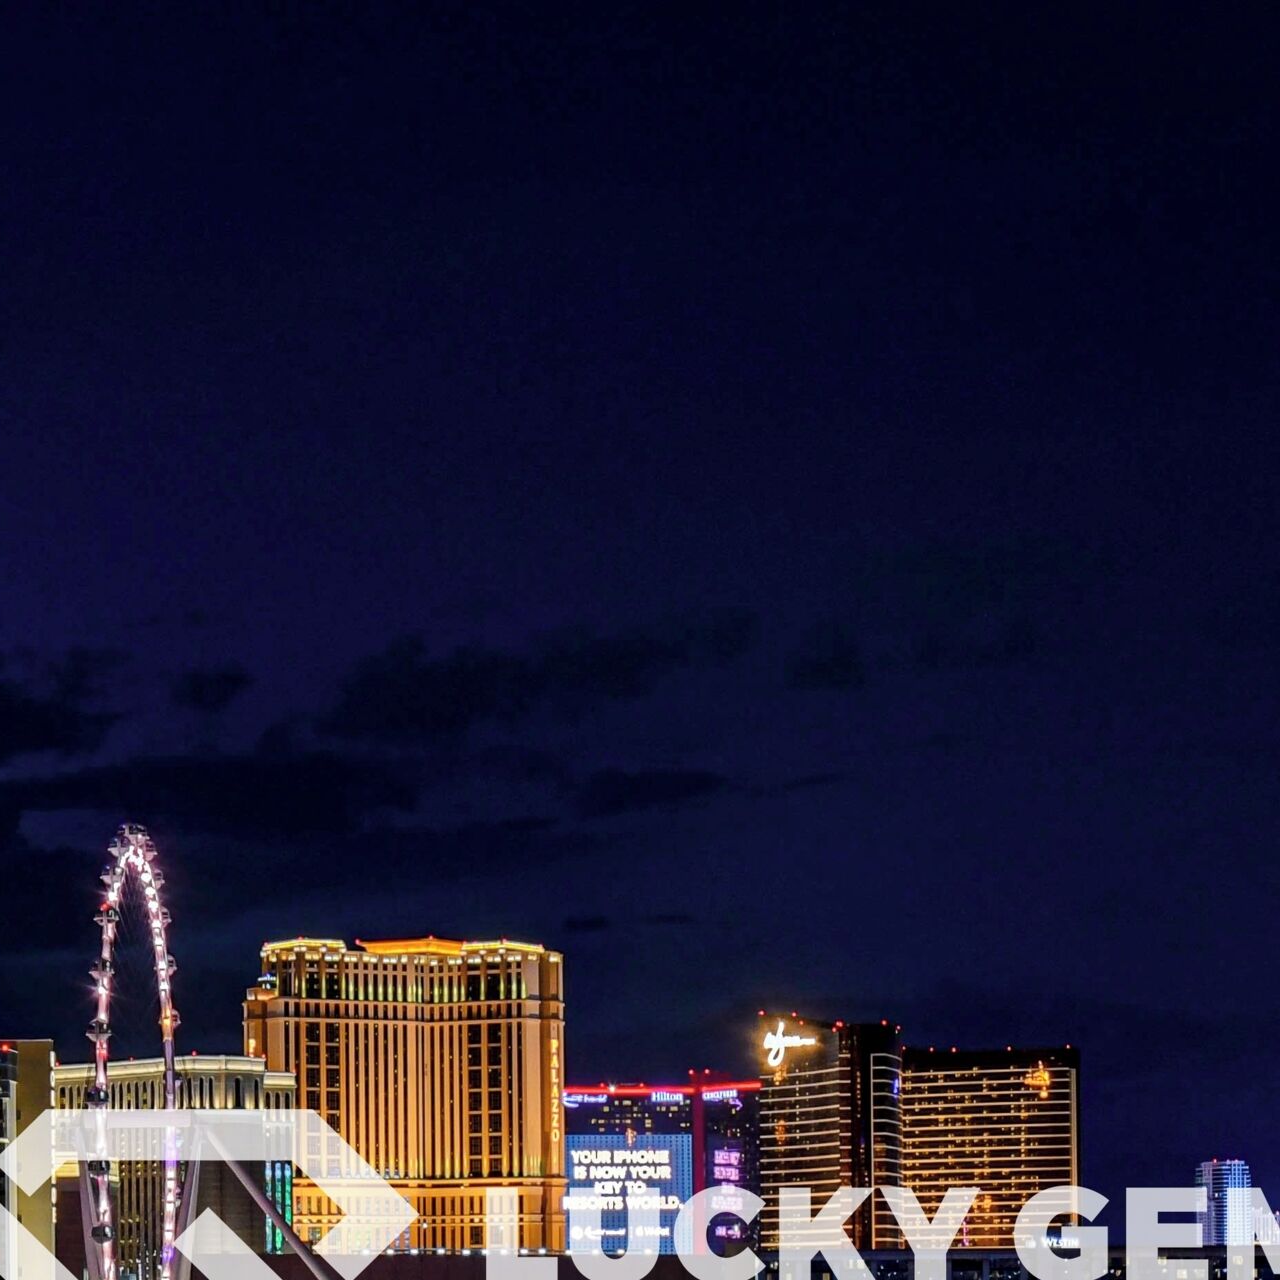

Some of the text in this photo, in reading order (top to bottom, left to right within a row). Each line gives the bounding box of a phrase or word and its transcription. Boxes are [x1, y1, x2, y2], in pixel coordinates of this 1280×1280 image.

[550, 1039, 560, 1142] PALAZZO
[651, 1091, 684, 1102] Hilton
[571, 1150, 612, 1164] YOUR
[589, 1166, 628, 1179] NOW
[629, 1166, 672, 1179] YOUR
[593, 1181, 647, 1194] KEY TO
